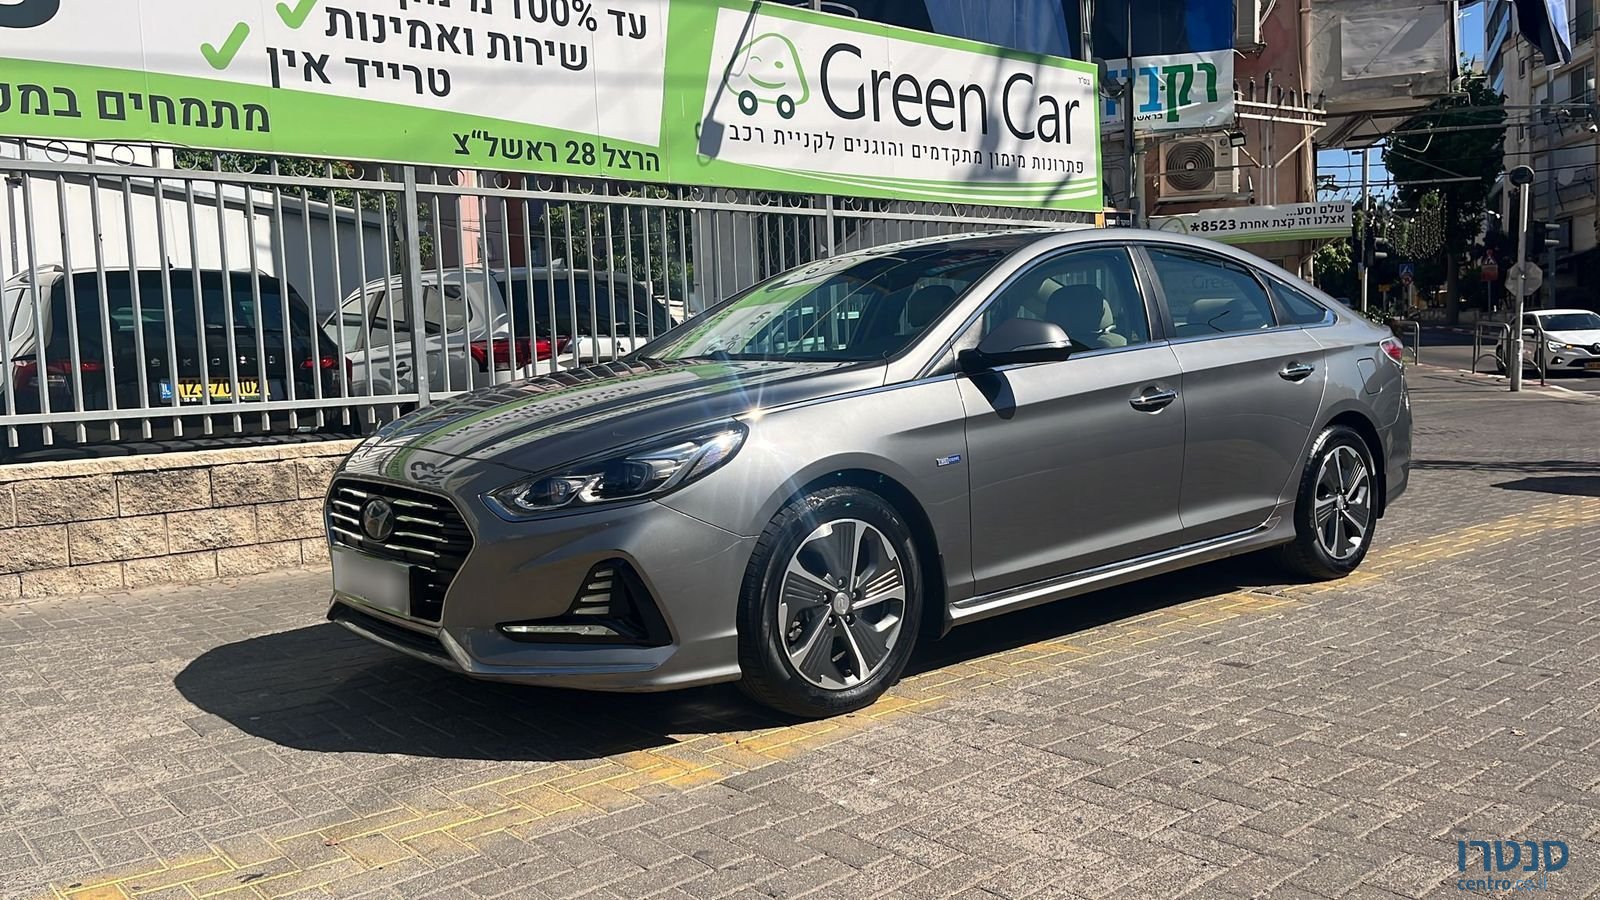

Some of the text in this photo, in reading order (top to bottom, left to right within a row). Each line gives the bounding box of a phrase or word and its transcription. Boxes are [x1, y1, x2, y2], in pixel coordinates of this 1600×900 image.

[325, 6, 588, 71] שירות ואמינות
[608, 9, 647, 40] עד
[266, 47, 451, 98] טרייד אין
[820, 43, 1080, 145] Green Car
[97, 90, 270, 133] מתמחים
[565, 140, 596, 166] 28
[602, 143, 660, 172] הרצל
[729, 124, 1084, 174] פתרונות מימון מתקדמים והוגנים לקניית רכב
[1271, 218, 1295, 229] קצת
[1298, 217, 1311, 226] זה
[1313, 215, 1345, 226] אצלנו
[1320, 204, 1345, 214] שלם
[1239, 219, 1269, 230] אחרת
